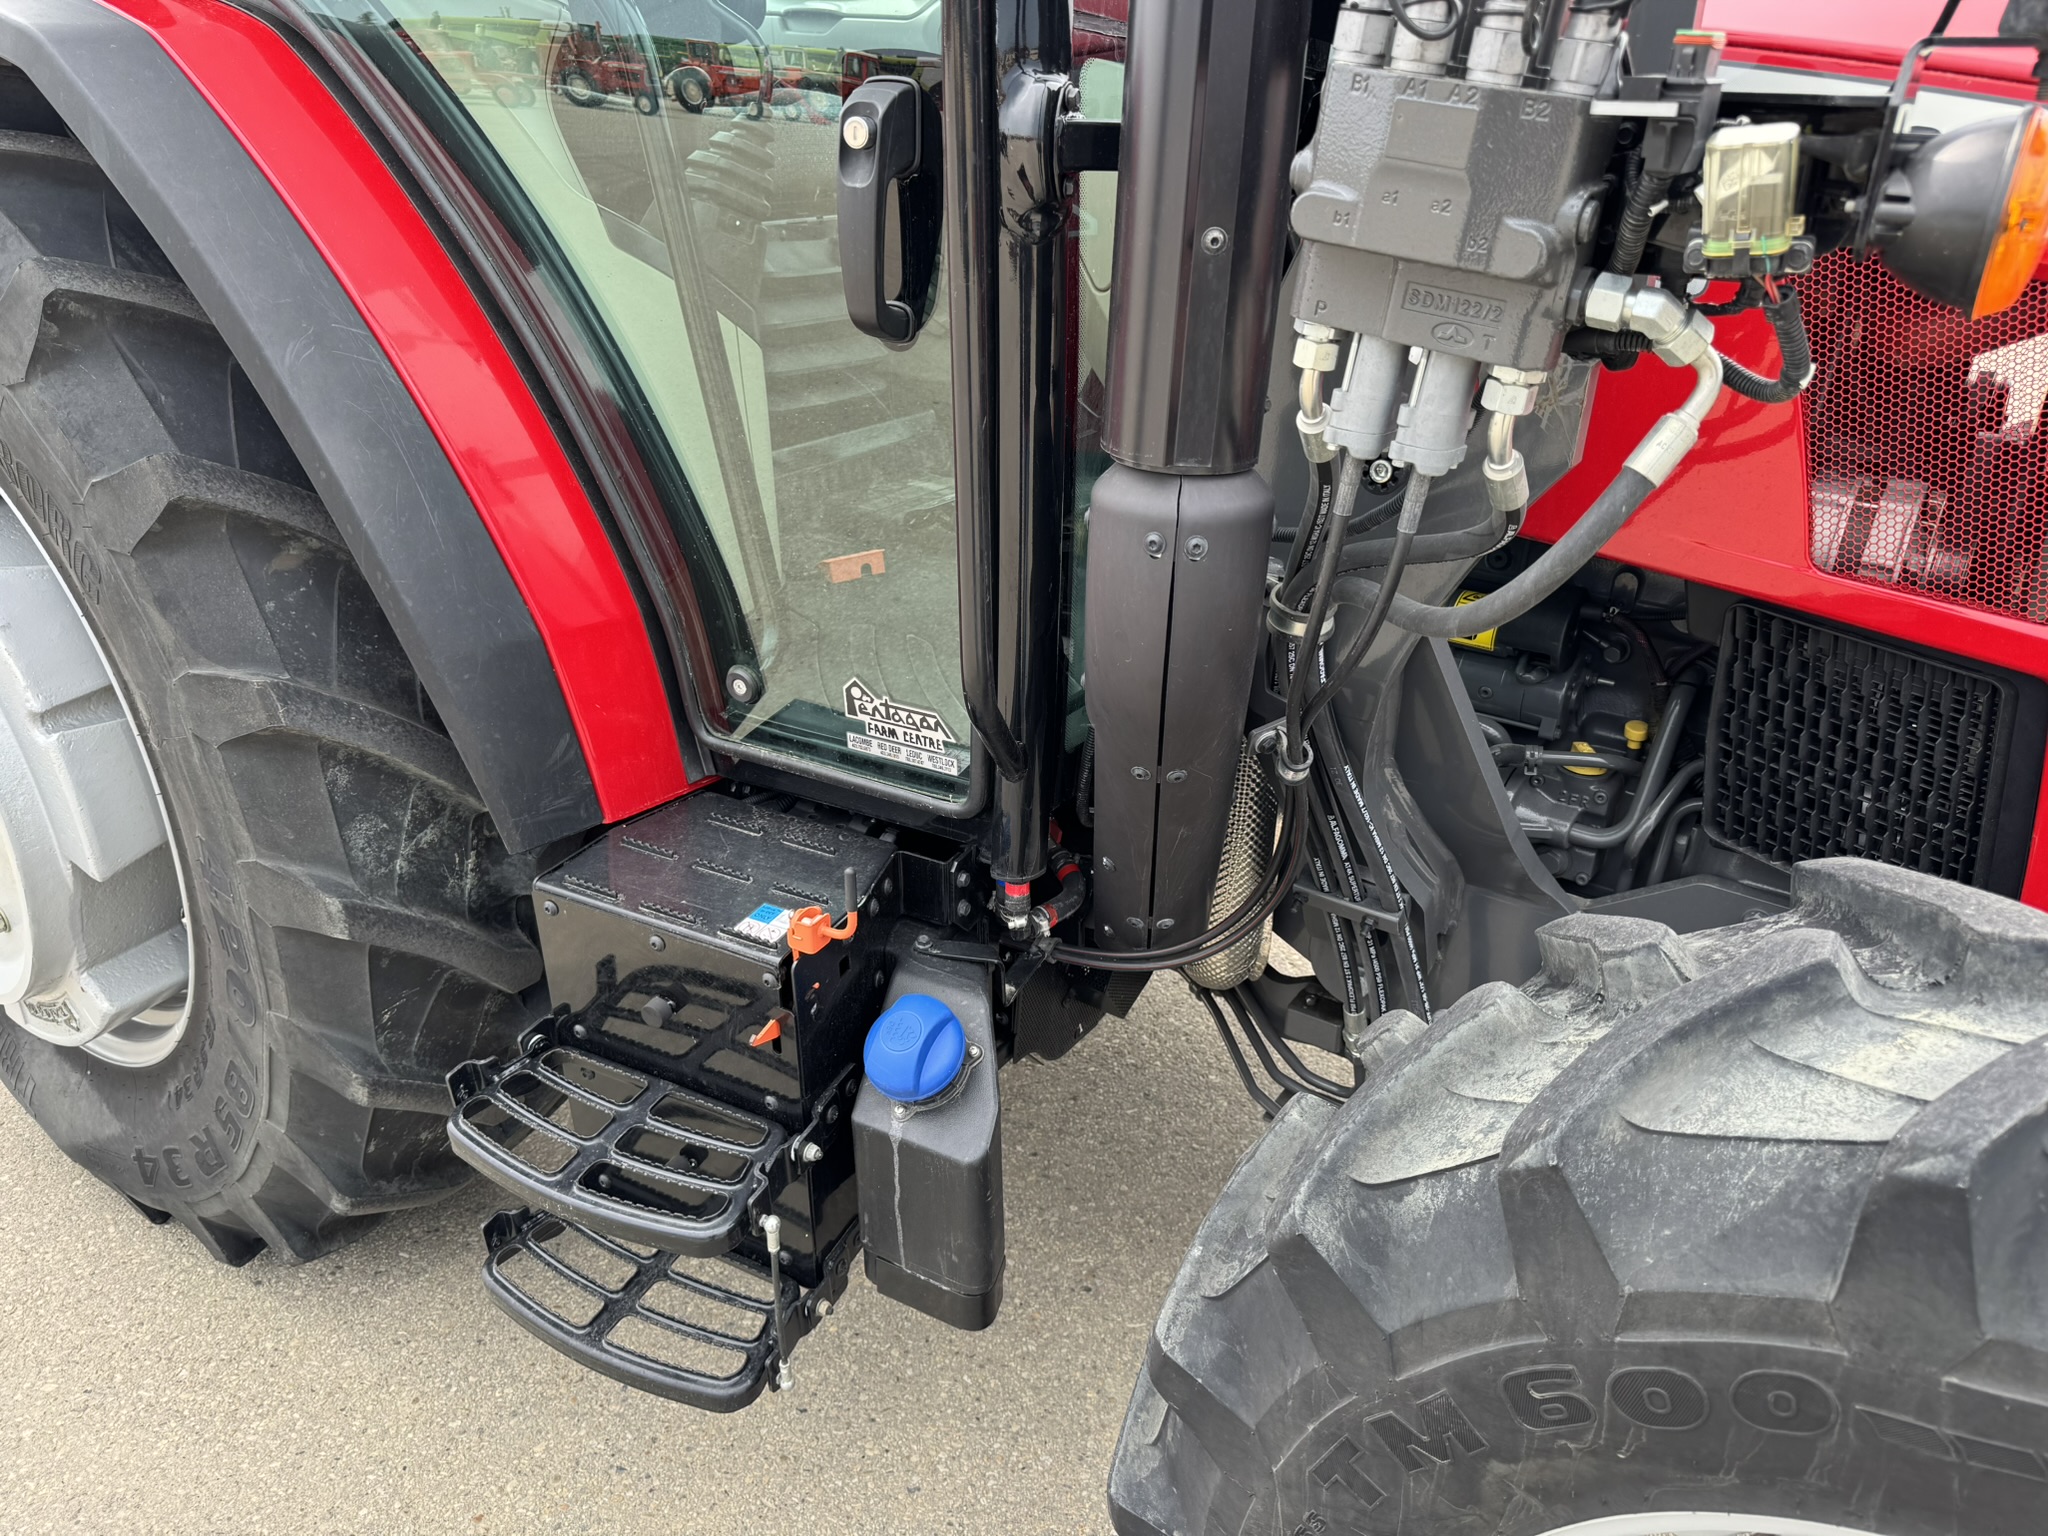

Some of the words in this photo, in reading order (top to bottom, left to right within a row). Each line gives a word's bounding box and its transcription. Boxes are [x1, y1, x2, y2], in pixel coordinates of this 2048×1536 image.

[1351, 71, 1371, 96] B1
[1401, 78, 1427, 100] A1
[1448, 84, 1480, 106] A2
[1519, 97, 1551, 123] B2
[1380, 188, 1400, 207] a1
[1430, 197, 1454, 218] a2
[1331, 207, 1352, 228] b1
[1465, 233, 1489, 254] b2
[1312, 299, 1328, 317] P
[1482, 333, 1497, 351] T
[844, 679, 953, 740] Pentagon
[867, 722, 899, 740] FARM
[903, 730, 943, 751] CENTRE
[849, 734, 873, 748] LACOMBE
[877, 742, 888, 752] RED
[888, 743, 902, 755] DEER
[905, 748, 923, 761] LEDUC
[926, 754, 956, 769] WESTLOCK
[1329, 820, 1348, 860] ALFAGOMMA
